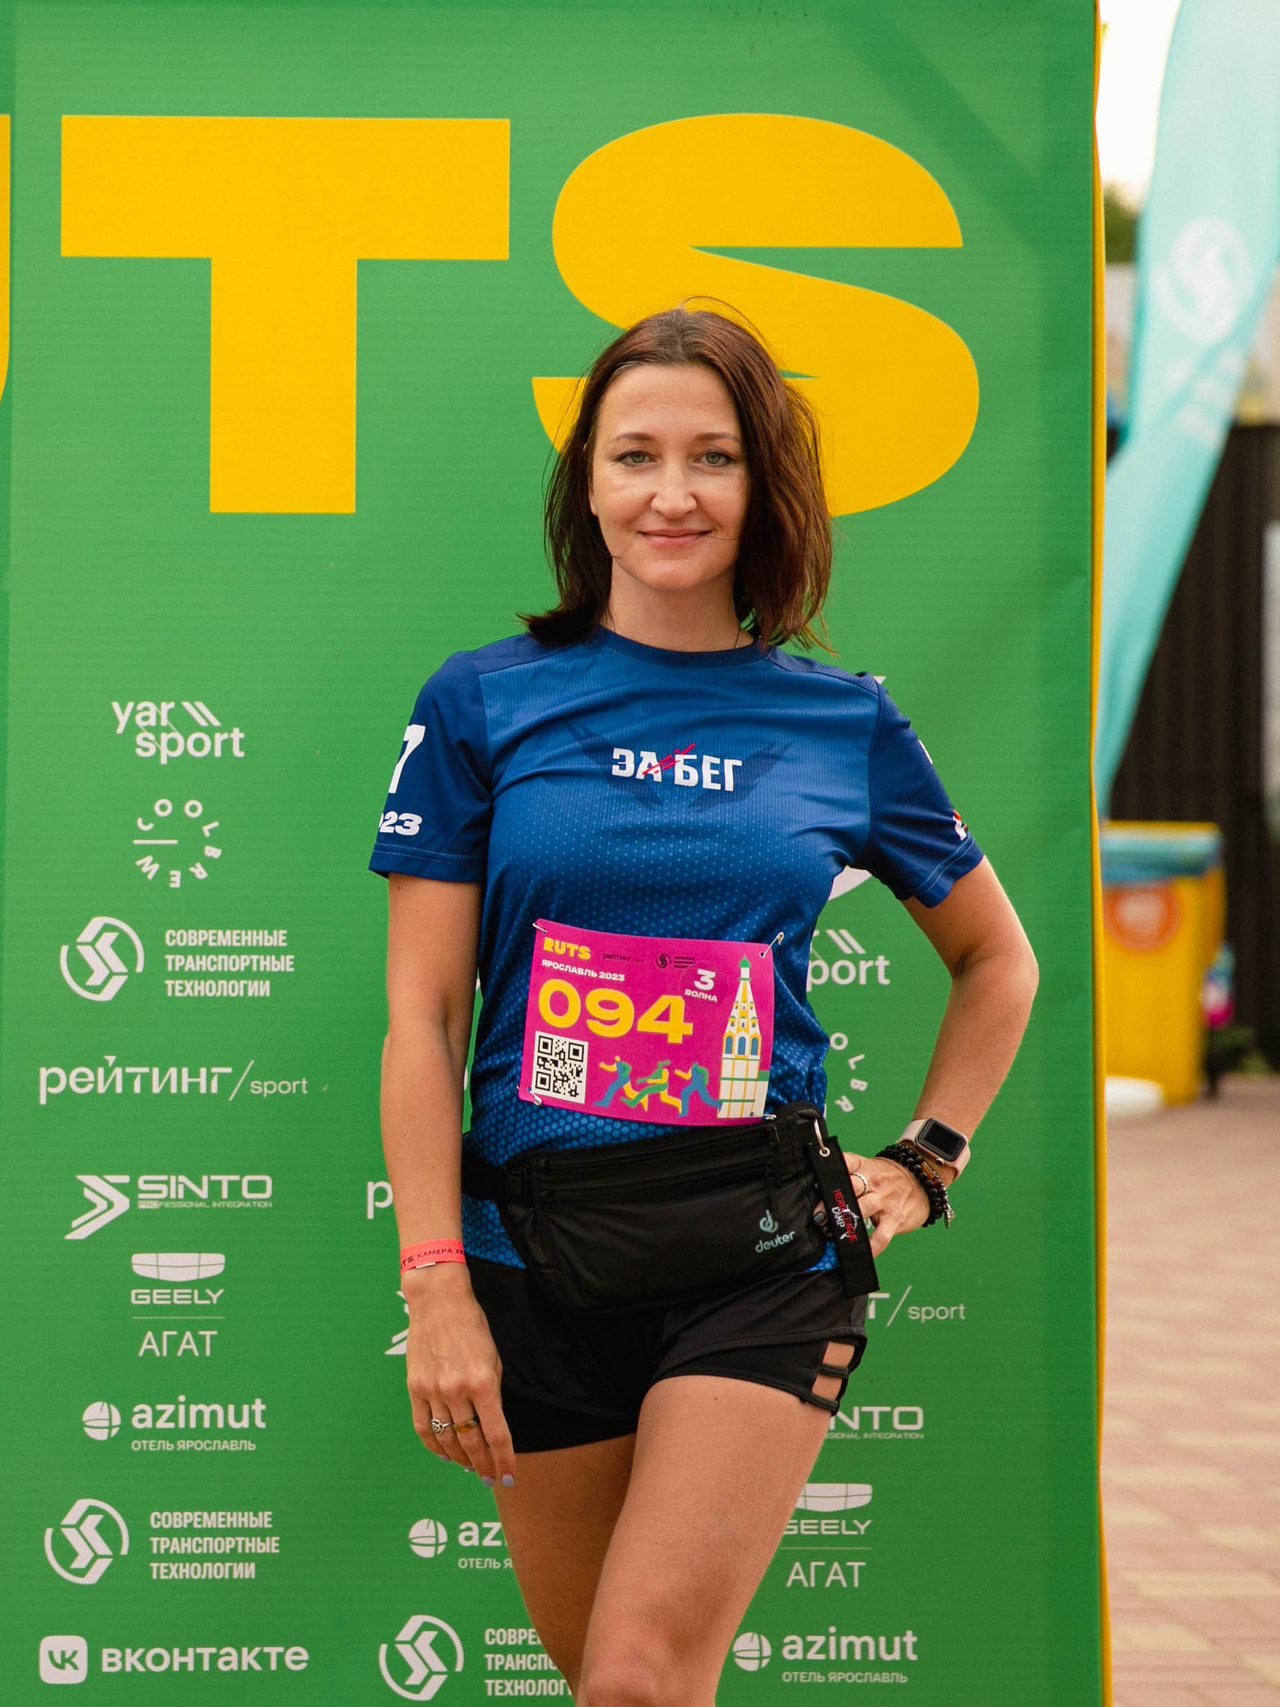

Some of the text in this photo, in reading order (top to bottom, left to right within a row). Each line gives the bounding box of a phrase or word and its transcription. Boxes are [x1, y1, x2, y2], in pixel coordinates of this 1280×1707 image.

[111, 700, 174, 734] yar
[136, 726, 244, 764] sport
[379, 811, 423, 836] 23
[165, 930, 287, 946] СОВРЕМЕННЫЕ
[543, 937, 591, 961] RUTS
[165, 955, 294, 971] ТРАНСПОРТНЫЕ
[541, 959, 625, 982] ЯРОСЛАВЛЬ 2023
[806, 955, 891, 992] port
[165, 980, 270, 996] ТЕХНОЛОГИИ
[694, 968, 716, 991] 3
[684, 988, 718, 1003] ВОЛНА
[538, 978, 694, 1044] 094
[138, 1175, 272, 1199] SINTO
[212, 1201, 272, 1209] INTEGRATION
[755, 1231, 797, 1253] deuter
[417, 1248, 453, 1259] КАМЕРА
[131, 1289, 224, 1304] GEELY
[139, 1331, 217, 1356] АГАТ
[132, 1395, 266, 1428] azimut
[829, 1406, 924, 1430] NTO
[131, 1440, 256, 1450] ОТЕЛЬ ЯРОСЛАВЛЬ
[150, 1512, 272, 1528] СОВРЕМЕННЫЕ
[150, 1537, 279, 1553] ТРАНСПОРТНЫЕ
[150, 1563, 255, 1579] ТЕХНОЛОГИИ
[458, 1558, 501, 1569] ОТЕЛЬ
[787, 1562, 865, 1587] АГАТ
[782, 1626, 917, 1660] azimut
[102, 1646, 309, 1672] вконтакте
[484, 1679, 572, 1696] ТЕХНОЛОГ
[782, 1672, 908, 1683] ОТЕЛЬ ЯРОСЛАВЛЬ
